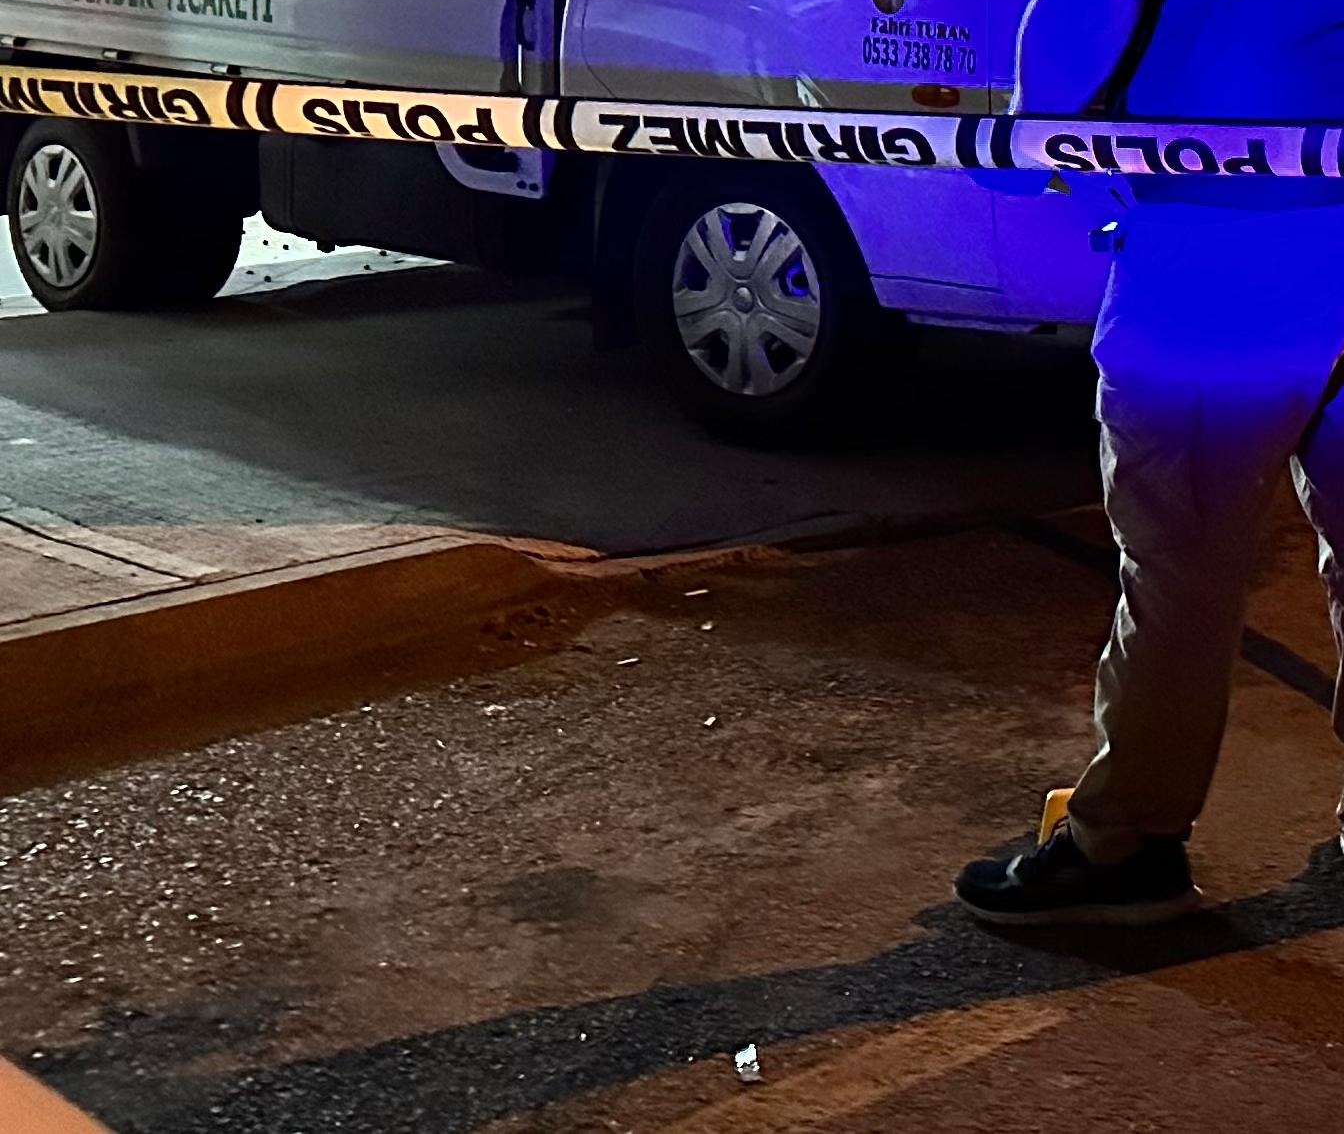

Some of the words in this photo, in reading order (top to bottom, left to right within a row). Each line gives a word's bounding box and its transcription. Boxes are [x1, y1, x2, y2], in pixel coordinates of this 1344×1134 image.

[915, 20, 970, 42] TURAN
[862, 36, 899, 66] 0533
[903, 40, 931, 70] 738
[934, 44, 953, 73] 78
[957, 46, 977, 74] 70
